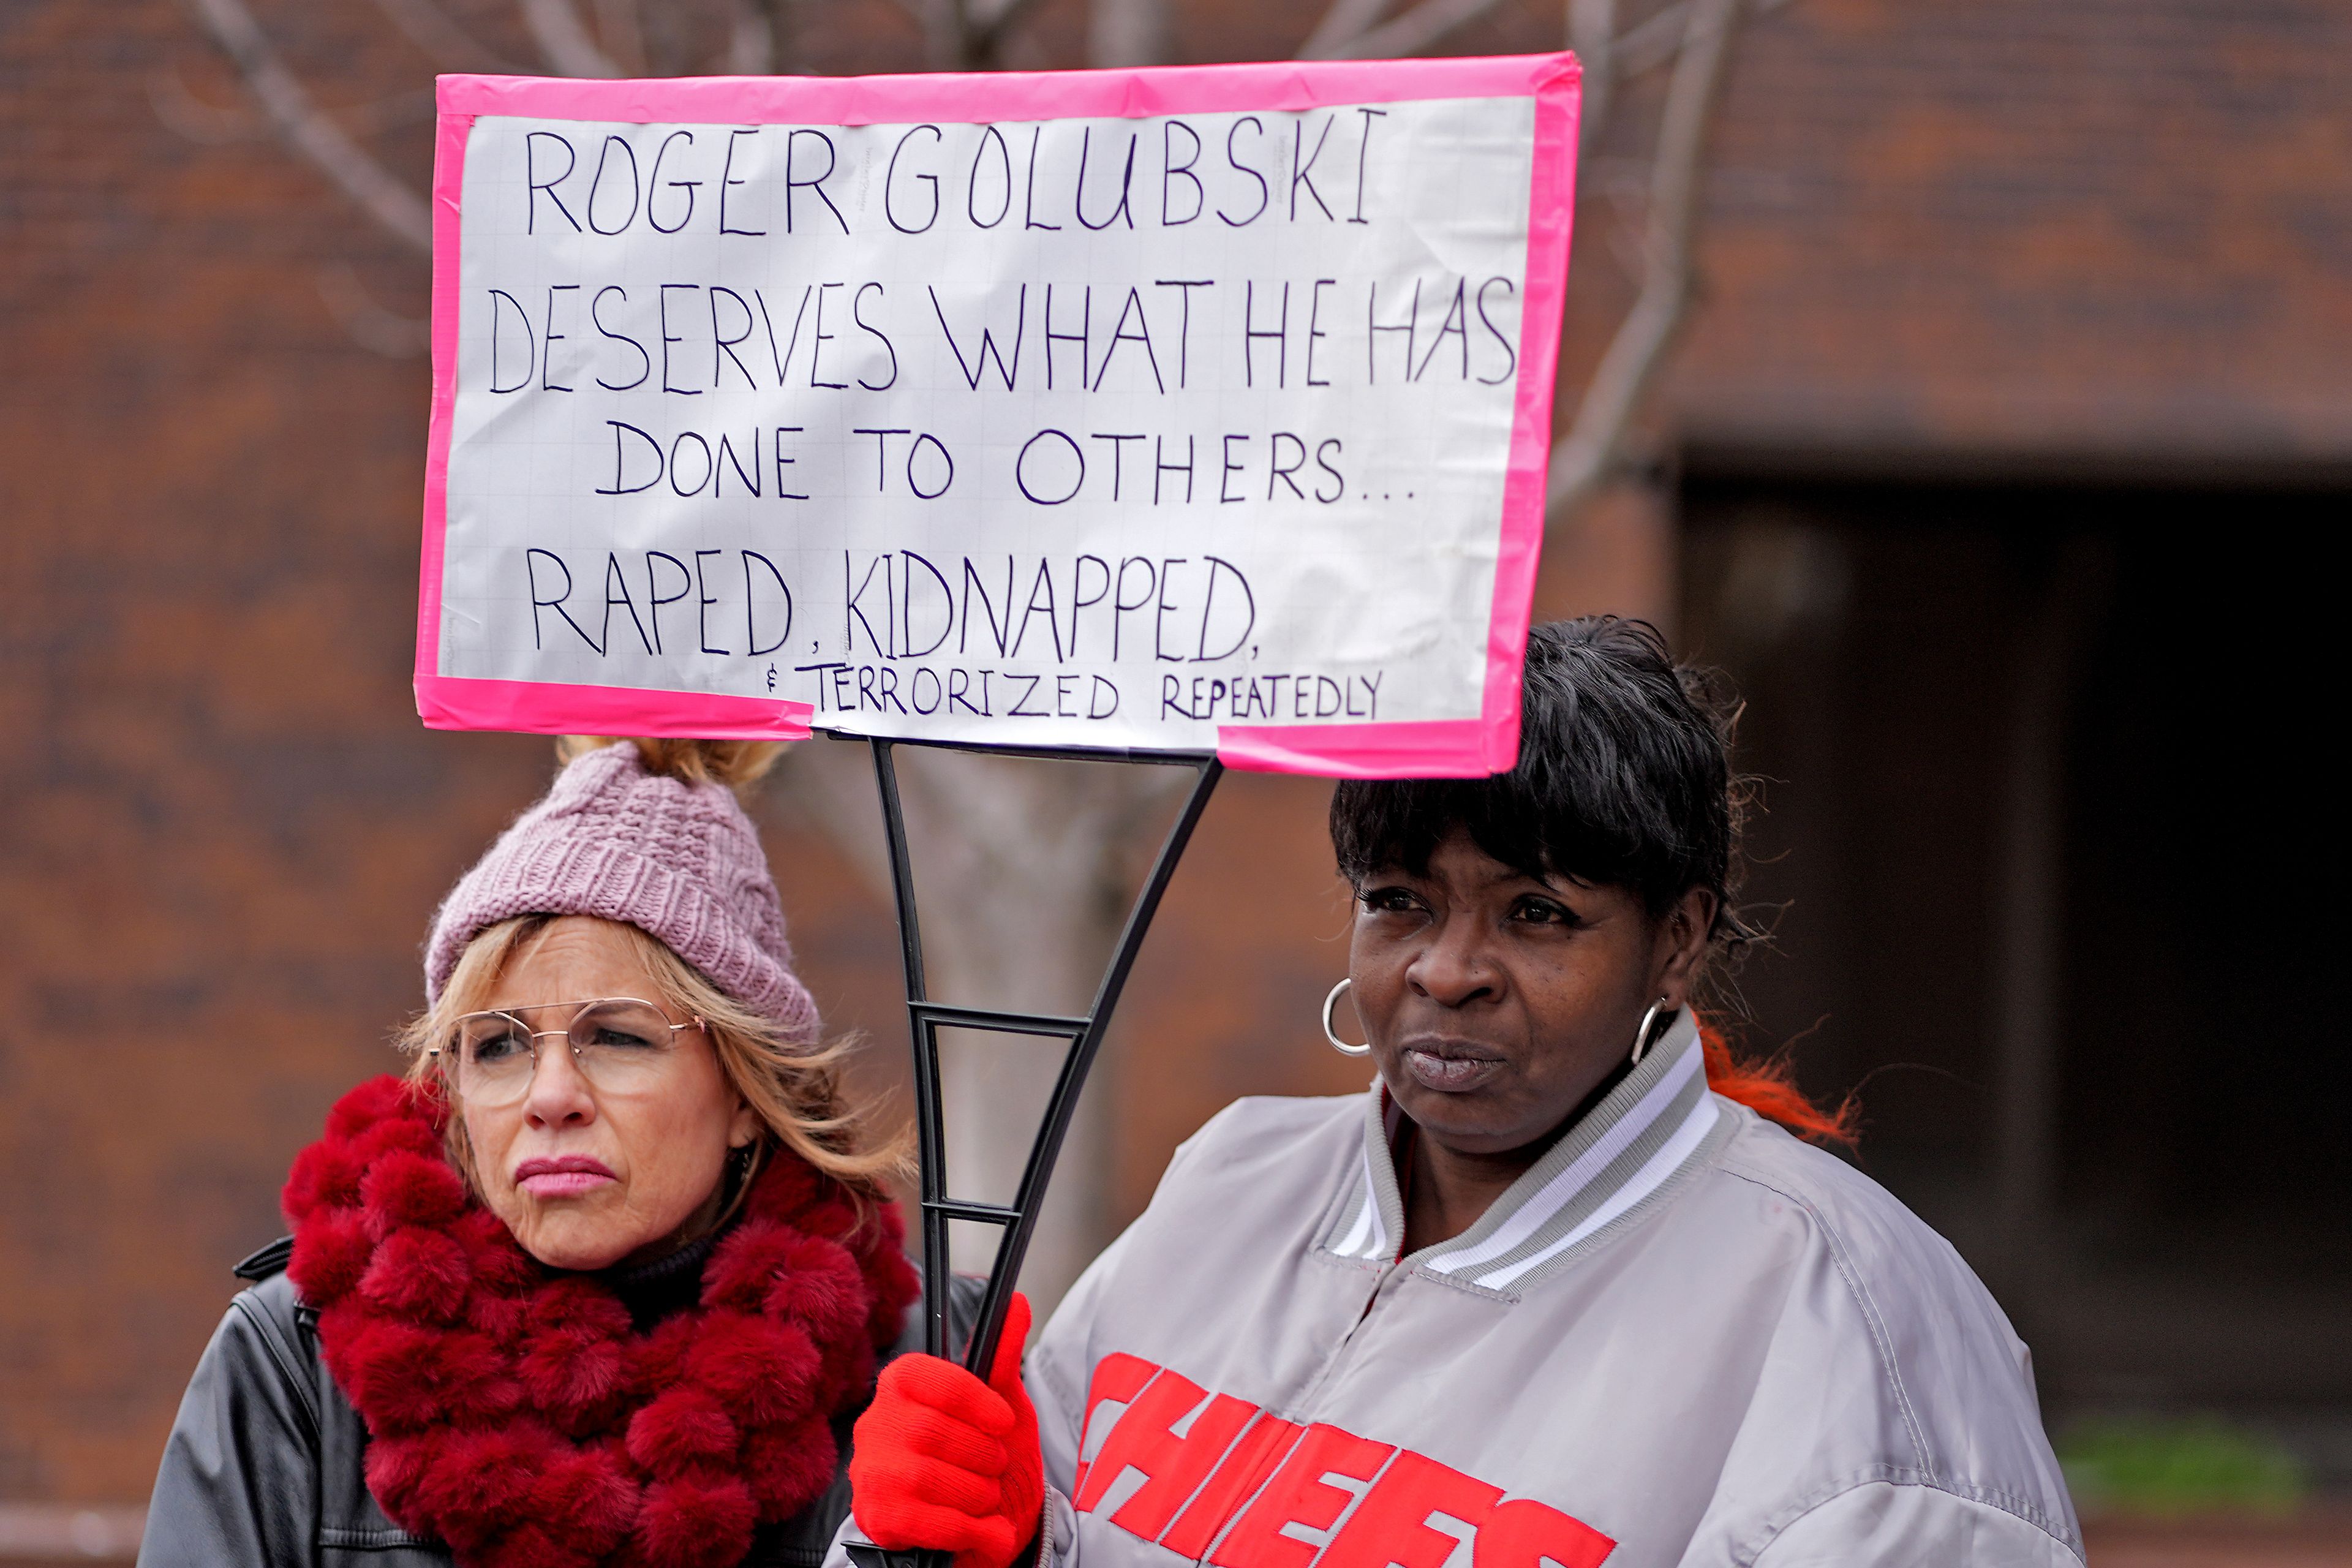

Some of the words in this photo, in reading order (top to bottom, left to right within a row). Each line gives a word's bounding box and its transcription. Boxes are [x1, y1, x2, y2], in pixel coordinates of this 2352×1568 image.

[526, 130, 850, 236] ROGER
[885, 108, 1387, 235] GOLUBSKI
[488, 282, 897, 395] DESERVES
[928, 279, 1215, 395] WHAT
[1245, 279, 1336, 390] HE
[1369, 275, 1516, 386] HAS
[595, 420, 810, 500] DONE
[853, 428, 954, 500] TO
[1016, 428, 1414, 506] OTHERS...
[526, 548, 820, 656] RAPED,
[845, 549, 1259, 663] KIDNAPPED,
[794, 662, 1120, 720] TERRORIZED
[1162, 670, 1383, 722] REPEATEDLY
